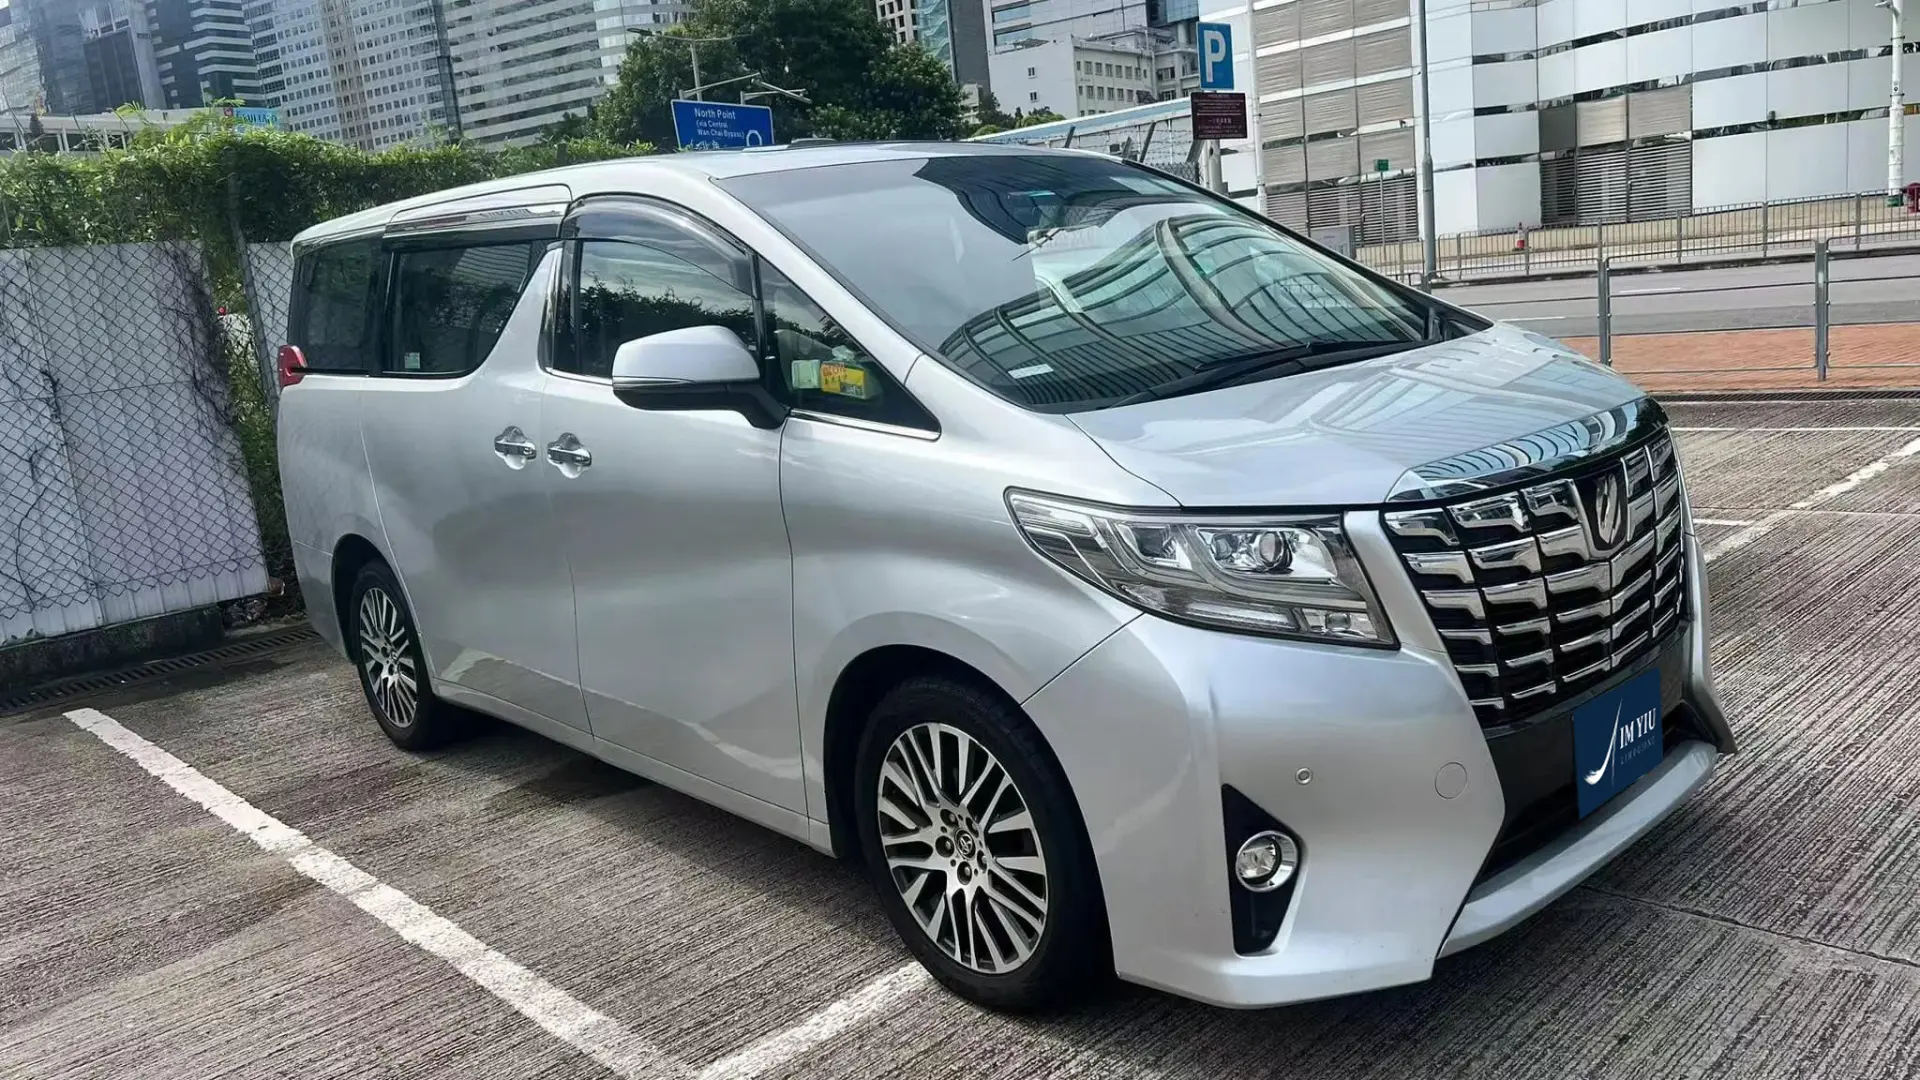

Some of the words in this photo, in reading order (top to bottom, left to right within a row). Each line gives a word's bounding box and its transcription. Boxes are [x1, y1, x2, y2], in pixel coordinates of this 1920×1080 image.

[1204, 30, 1226, 83] P
[694, 107, 716, 119] North
[717, 109, 736, 120] Point
[696, 120, 708, 128] (via
[708, 120, 729, 129] Central
[711, 129, 724, 137] Chai
[724, 130, 745, 140] Bypass)
